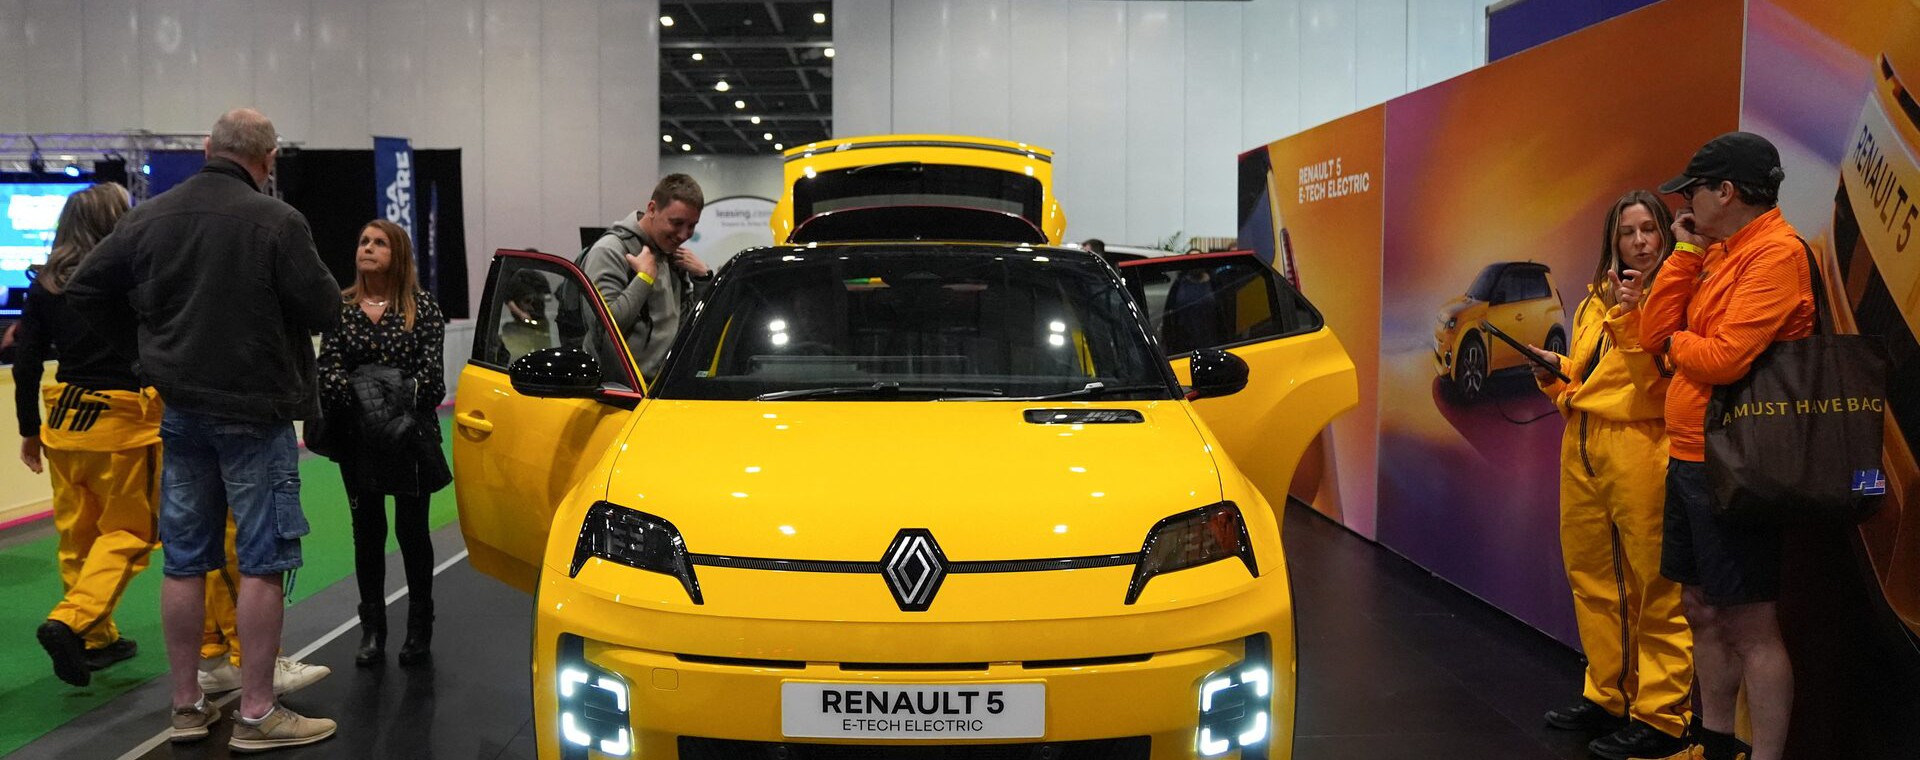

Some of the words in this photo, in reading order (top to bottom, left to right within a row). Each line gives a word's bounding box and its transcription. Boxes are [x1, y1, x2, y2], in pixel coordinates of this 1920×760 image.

[1298, 159, 1335, 186] RENAULT
[1336, 156, 1342, 177] 5
[1298, 181, 1326, 204] E-TECH
[1327, 172, 1370, 198] ELECTRIC
[1853, 124, 1908, 233] RENAULT
[1896, 203, 1919, 253] 5
[1722, 412, 1732, 426] A
[1734, 402, 1788, 418] MUST
[1796, 398, 1843, 414] HAVE
[1847, 397, 1882, 412] BAG
[822, 690, 979, 714] RENAULT
[986, 691, 1005, 714] 5
[842, 719, 901, 732] E-TECH
[905, 719, 984, 732] ELECTRIC
